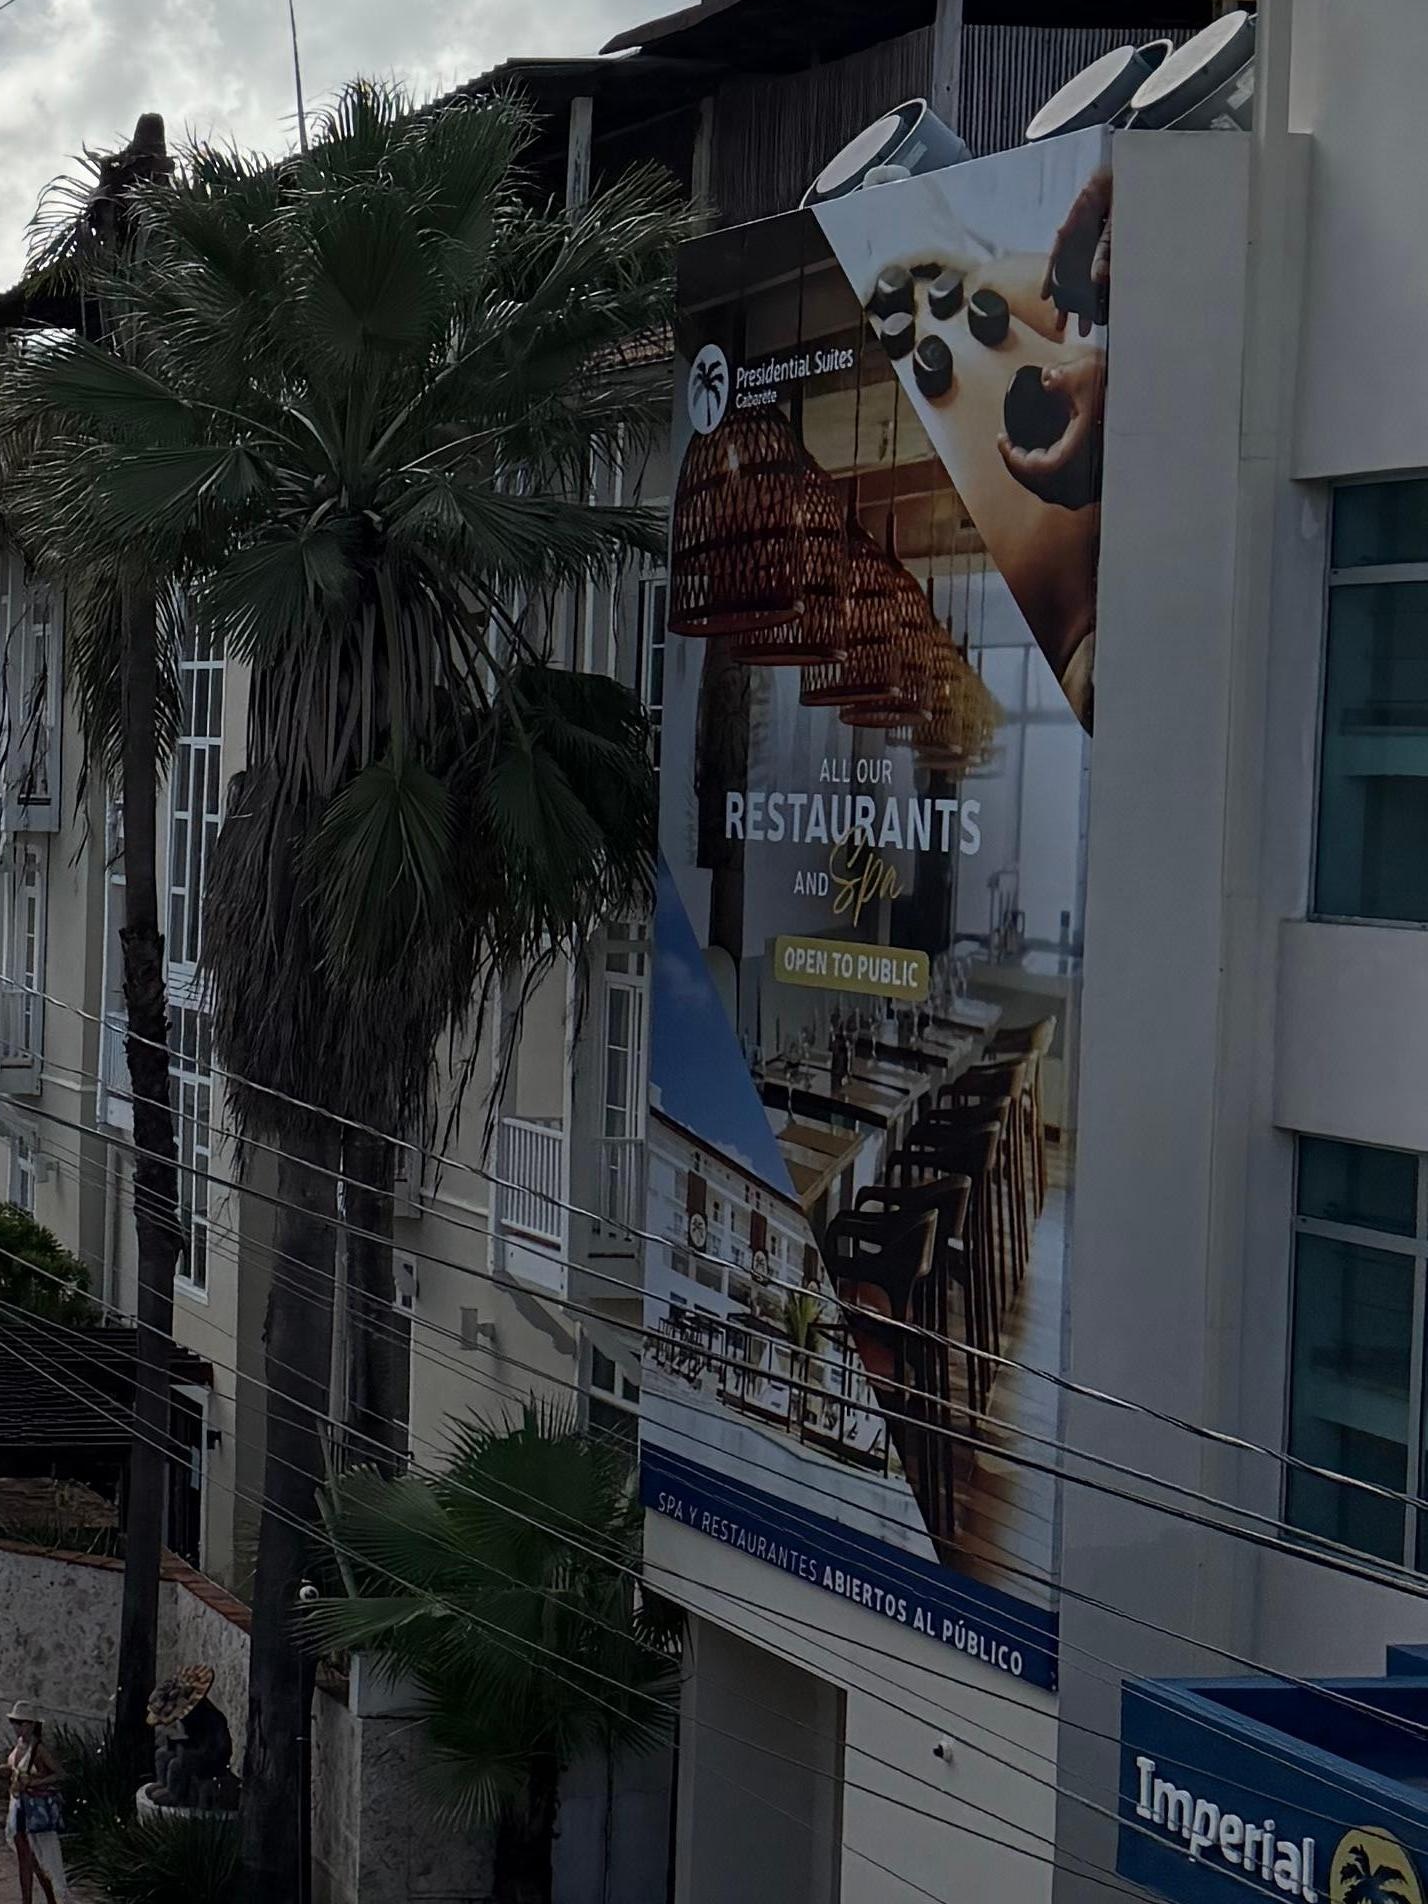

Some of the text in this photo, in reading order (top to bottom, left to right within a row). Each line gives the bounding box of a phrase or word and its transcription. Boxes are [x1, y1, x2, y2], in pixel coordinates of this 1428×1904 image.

[736, 348, 854, 389] Presidential Suites
[735, 388, 778, 408] Cabarete
[819, 758, 893, 785] ALL OUR
[724, 791, 982, 856] RESTAURANTS
[793, 824, 904, 928] AND Spa
[783, 946, 919, 988] OPEN TO PUBLIC
[657, 1491, 1023, 1676] SPA Y RESTAURANTES ABIERTOS AL PÚBLICO
[1136, 1756, 1318, 1904] Imperial
